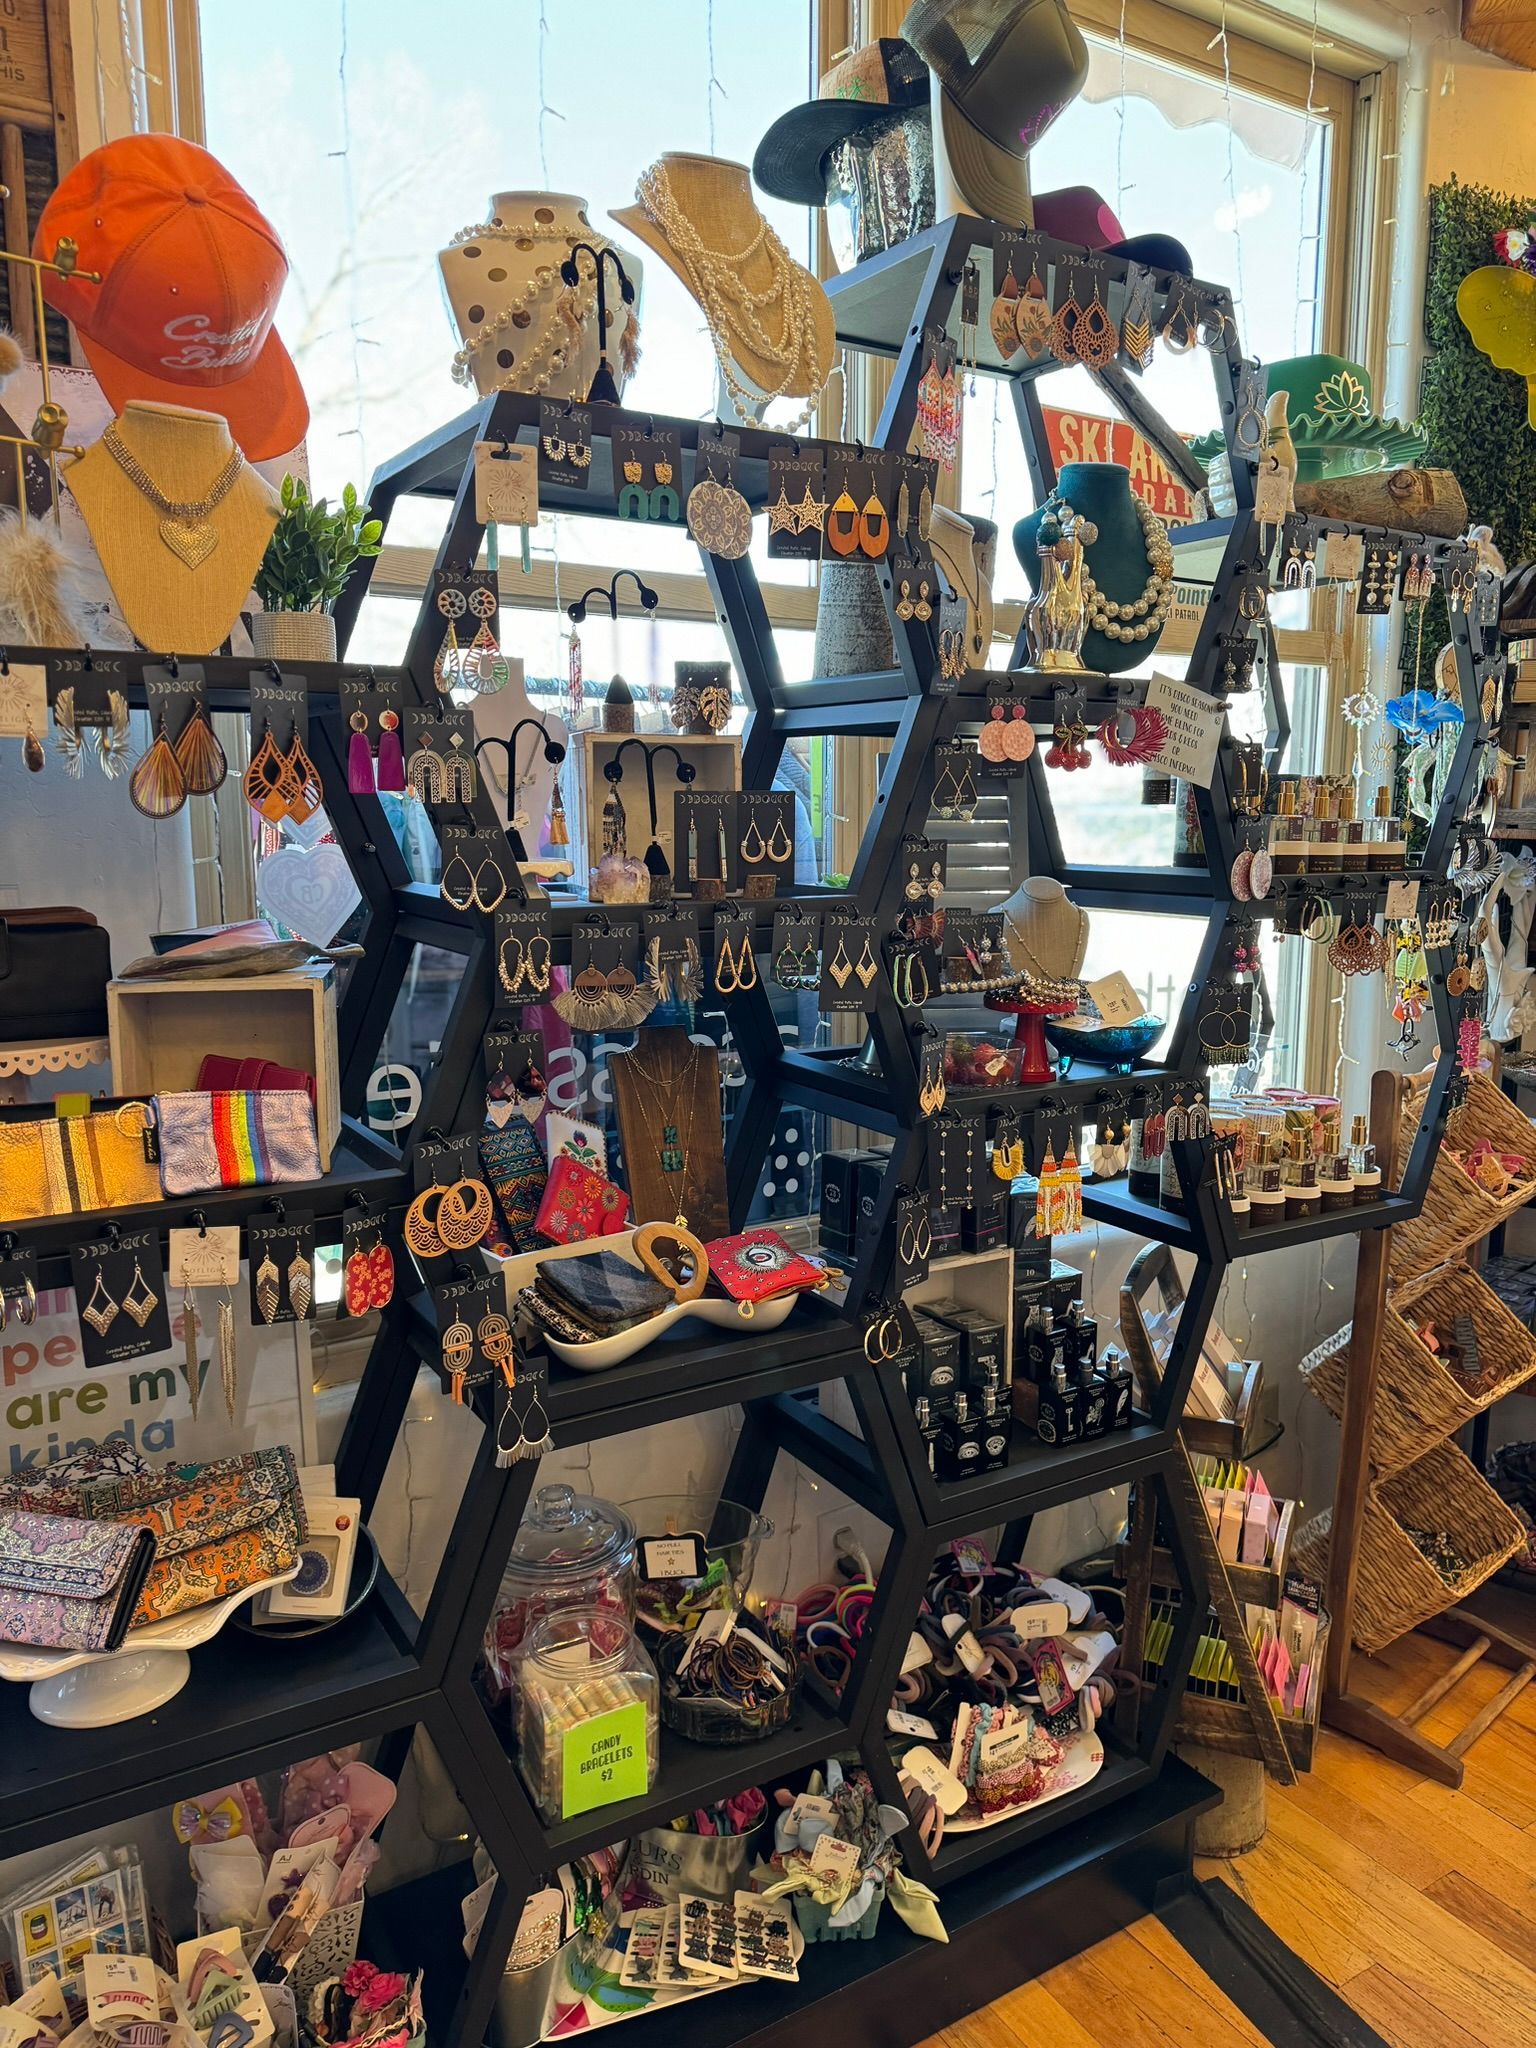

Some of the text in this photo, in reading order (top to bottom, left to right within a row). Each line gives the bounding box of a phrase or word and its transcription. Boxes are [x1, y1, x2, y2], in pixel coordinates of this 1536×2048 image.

[1059, 414, 1114, 464] SKI
[1175, 608, 1199, 621] PATROL
[1160, 683, 1172, 697] IT'S
[1173, 689, 1191, 705] DISCO
[1170, 702, 1198, 721] YOU NEED
[1174, 717, 1193, 735] BLING
[1193, 726, 1205, 738] FOR
[1171, 745, 1181, 756] OR
[1169, 758, 1196, 776] INFERNO!
[1026, 1268, 1035, 1277] 10
[6, 1359, 210, 1430] are my
[9, 1419, 176, 1475] kinda
[591, 1733, 621, 1754] CANDY
[580, 1745, 633, 1774] BRACELETS
[601, 1767, 613, 1781] $2
[279, 1854, 293, 1862] AJ
[632, 1839, 682, 1870] URS
